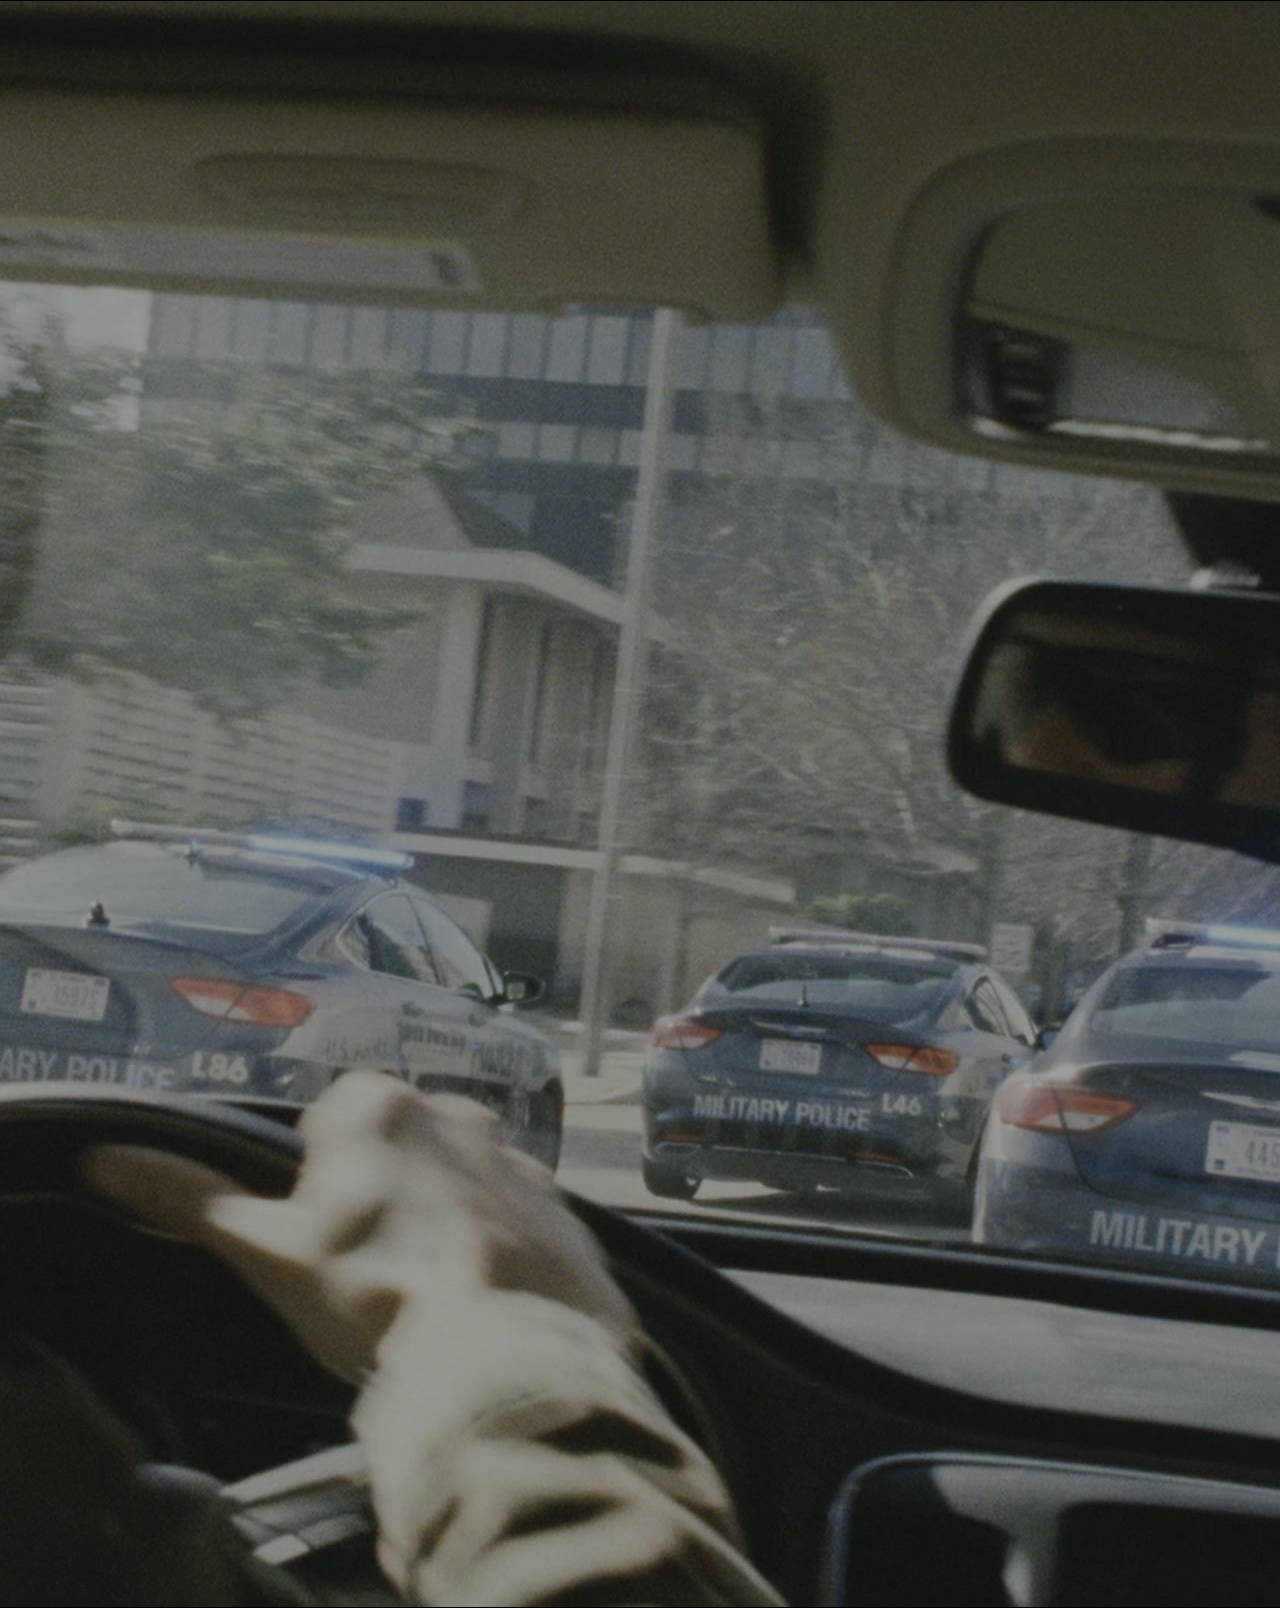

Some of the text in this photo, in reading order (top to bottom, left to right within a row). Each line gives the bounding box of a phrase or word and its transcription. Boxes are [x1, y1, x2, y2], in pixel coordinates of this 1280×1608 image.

[66, 1054, 176, 1091] POLICE
[192, 1049, 249, 1083] L86
[693, 1094, 871, 1131] MILITARY POLICE
[881, 1092, 922, 1116] L46
[1090, 1210, 1267, 1265] MILITARY
